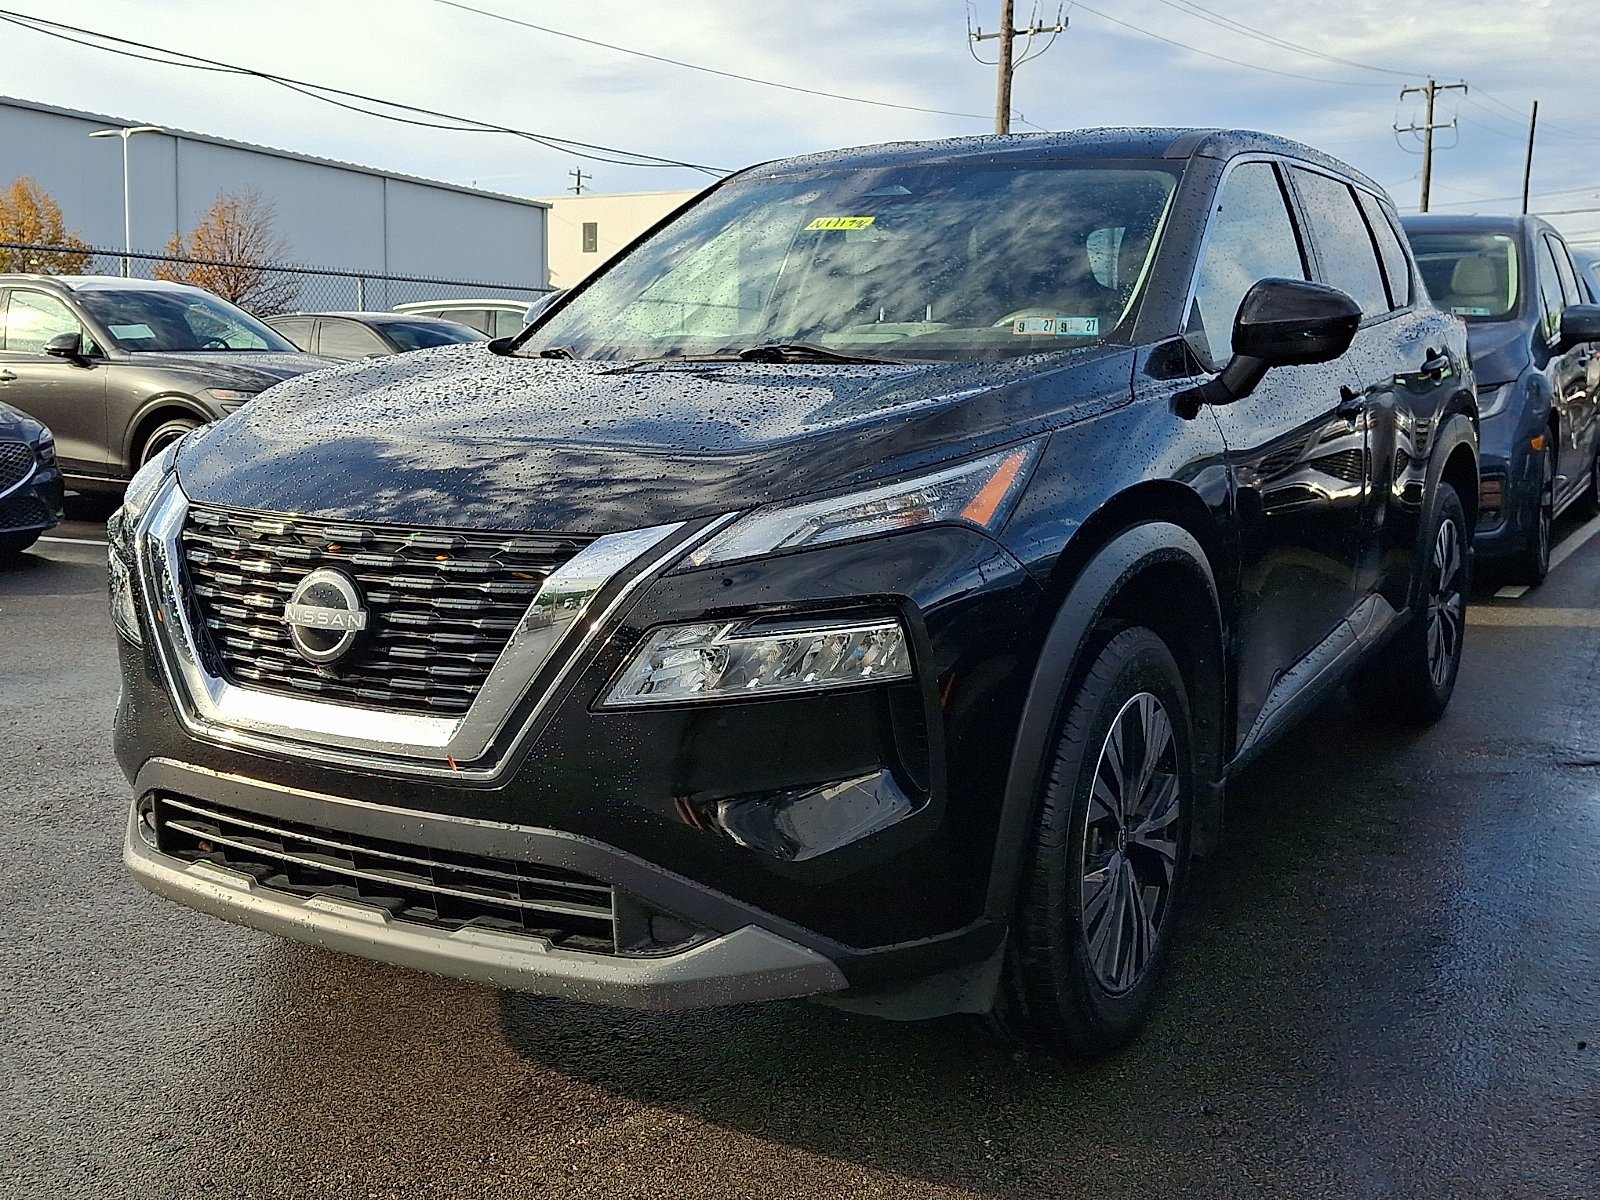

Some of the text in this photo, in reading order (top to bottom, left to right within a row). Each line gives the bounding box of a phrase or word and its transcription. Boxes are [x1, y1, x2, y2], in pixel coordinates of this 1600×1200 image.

[1018, 319, 1054, 333] 9 27
[1060, 319, 1096, 333] 9 27
[285, 605, 363, 628] NISSAN
